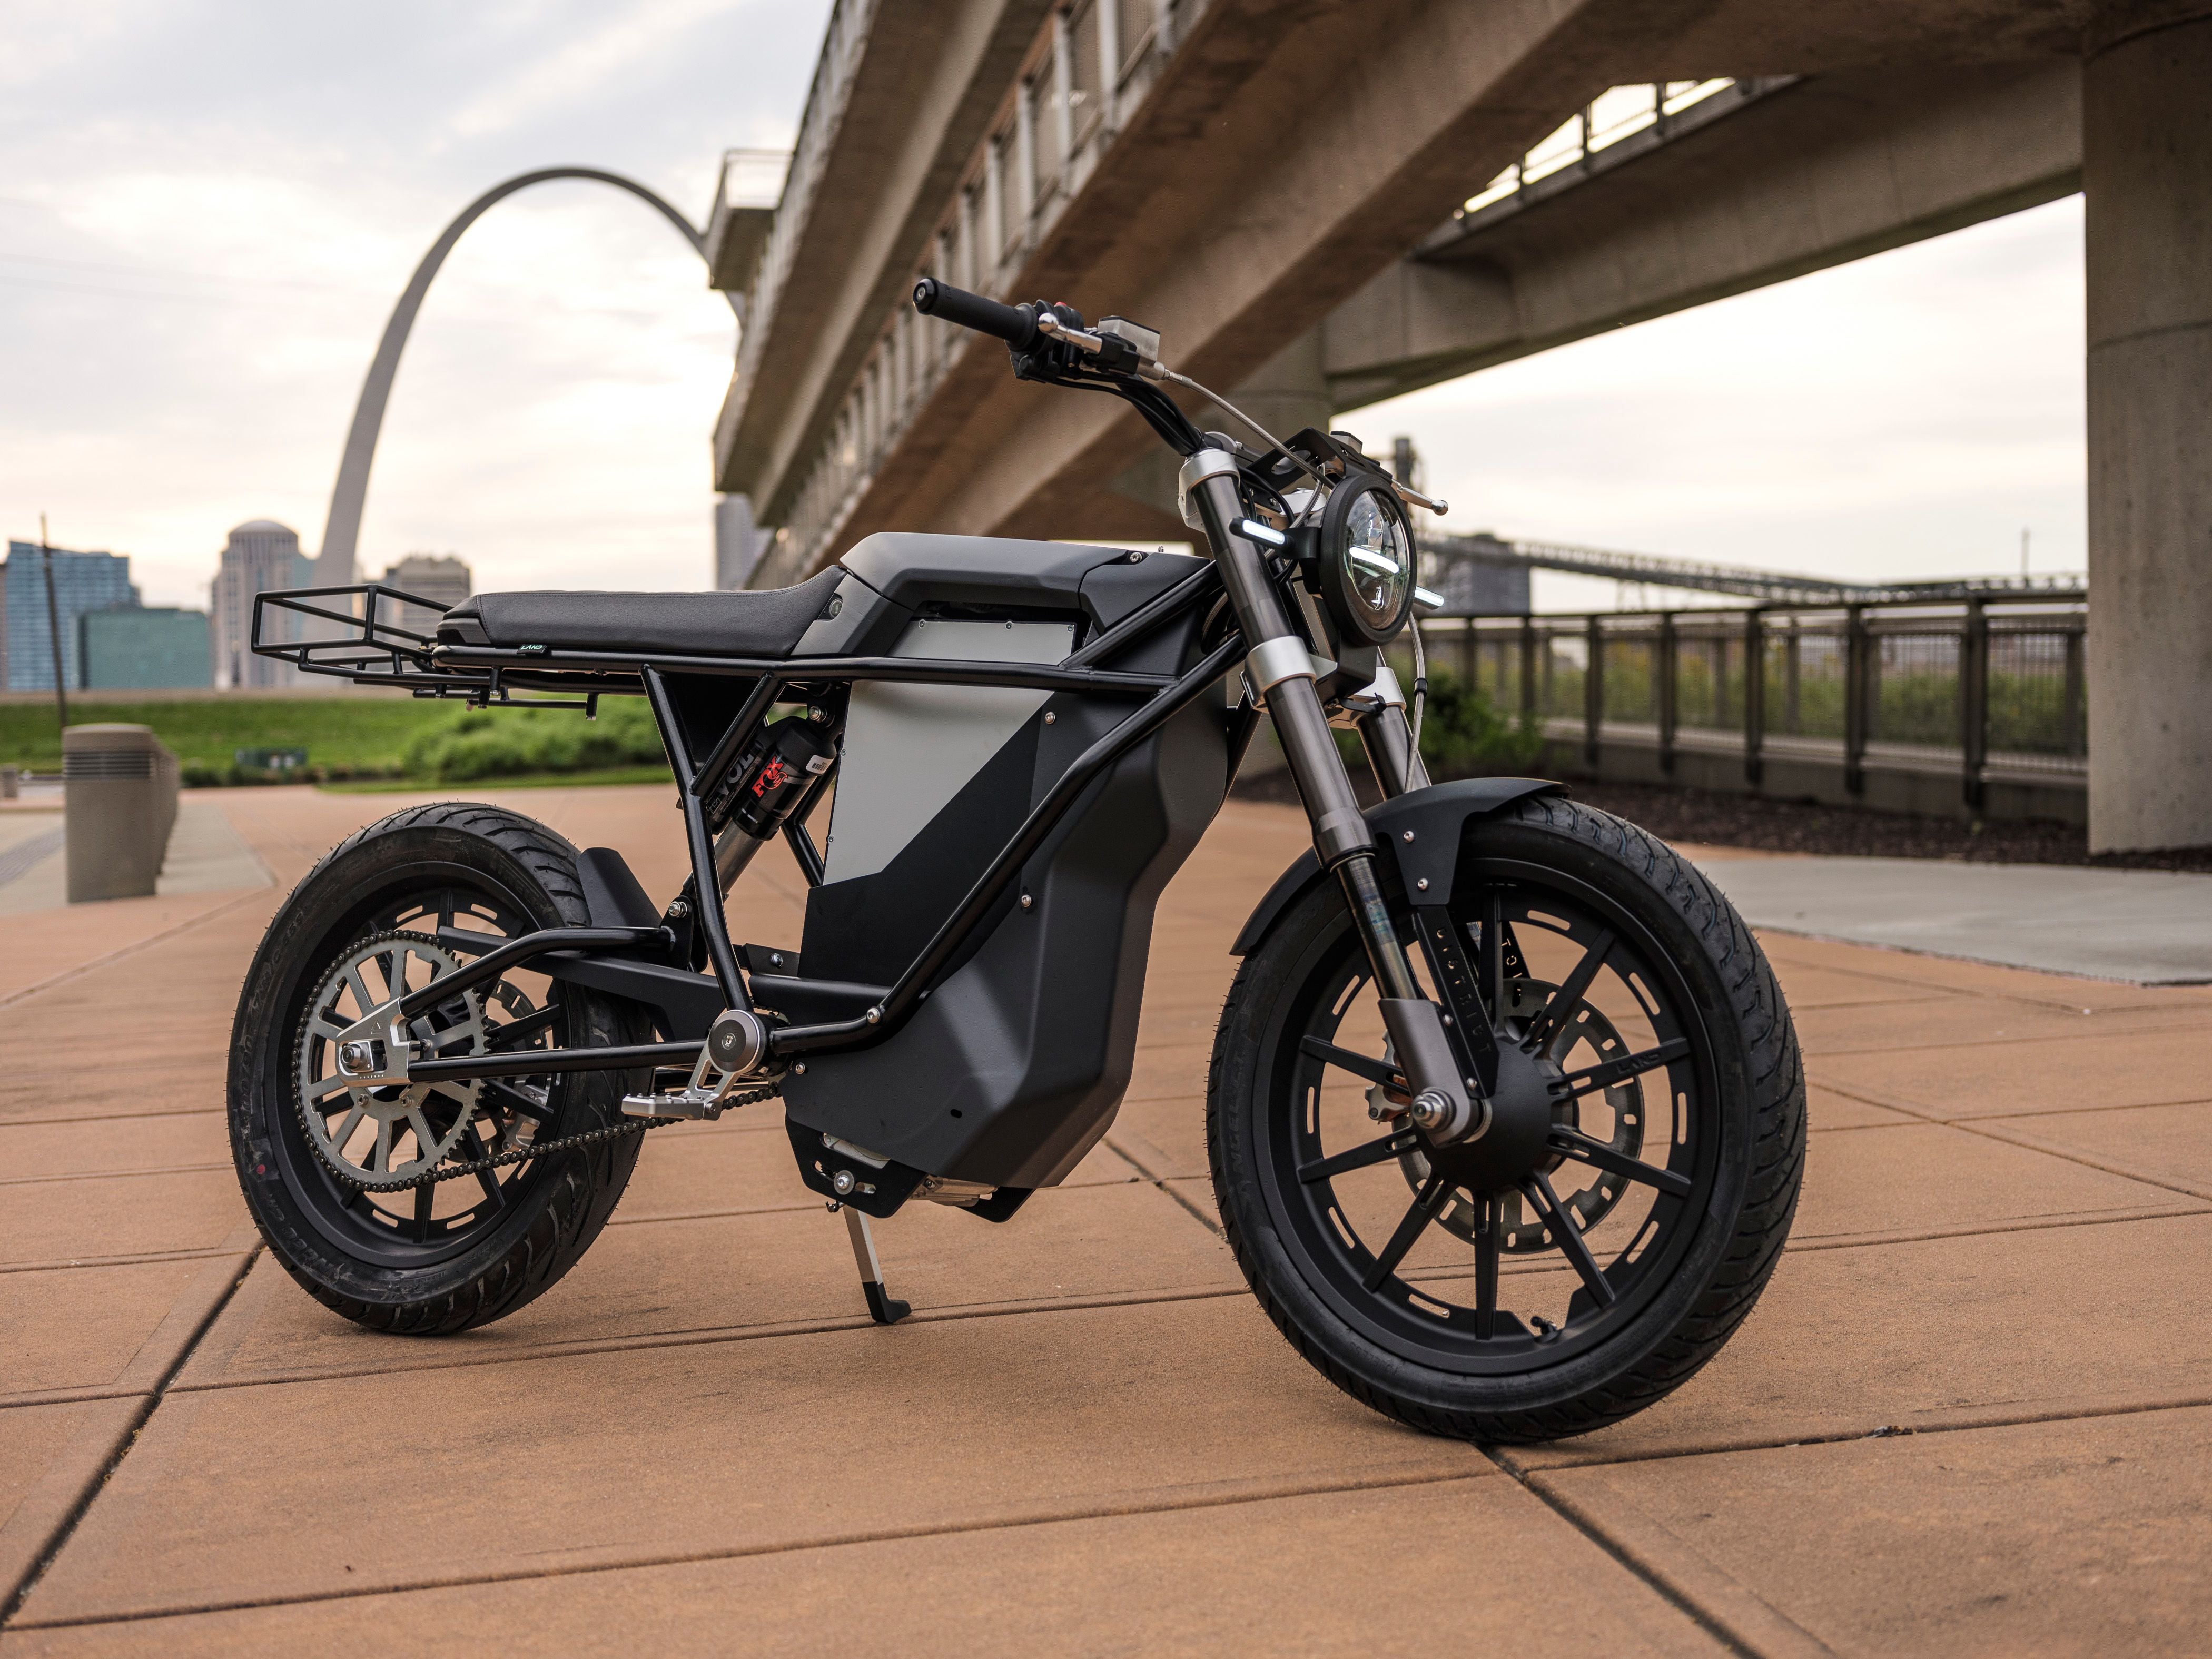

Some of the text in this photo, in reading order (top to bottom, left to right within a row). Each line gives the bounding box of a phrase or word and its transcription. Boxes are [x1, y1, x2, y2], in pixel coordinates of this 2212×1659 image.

[752, 756, 788, 797] FOX
[1436, 927, 1492, 1052] DISTRICT
[1615, 1053, 1660, 1075] LAND
